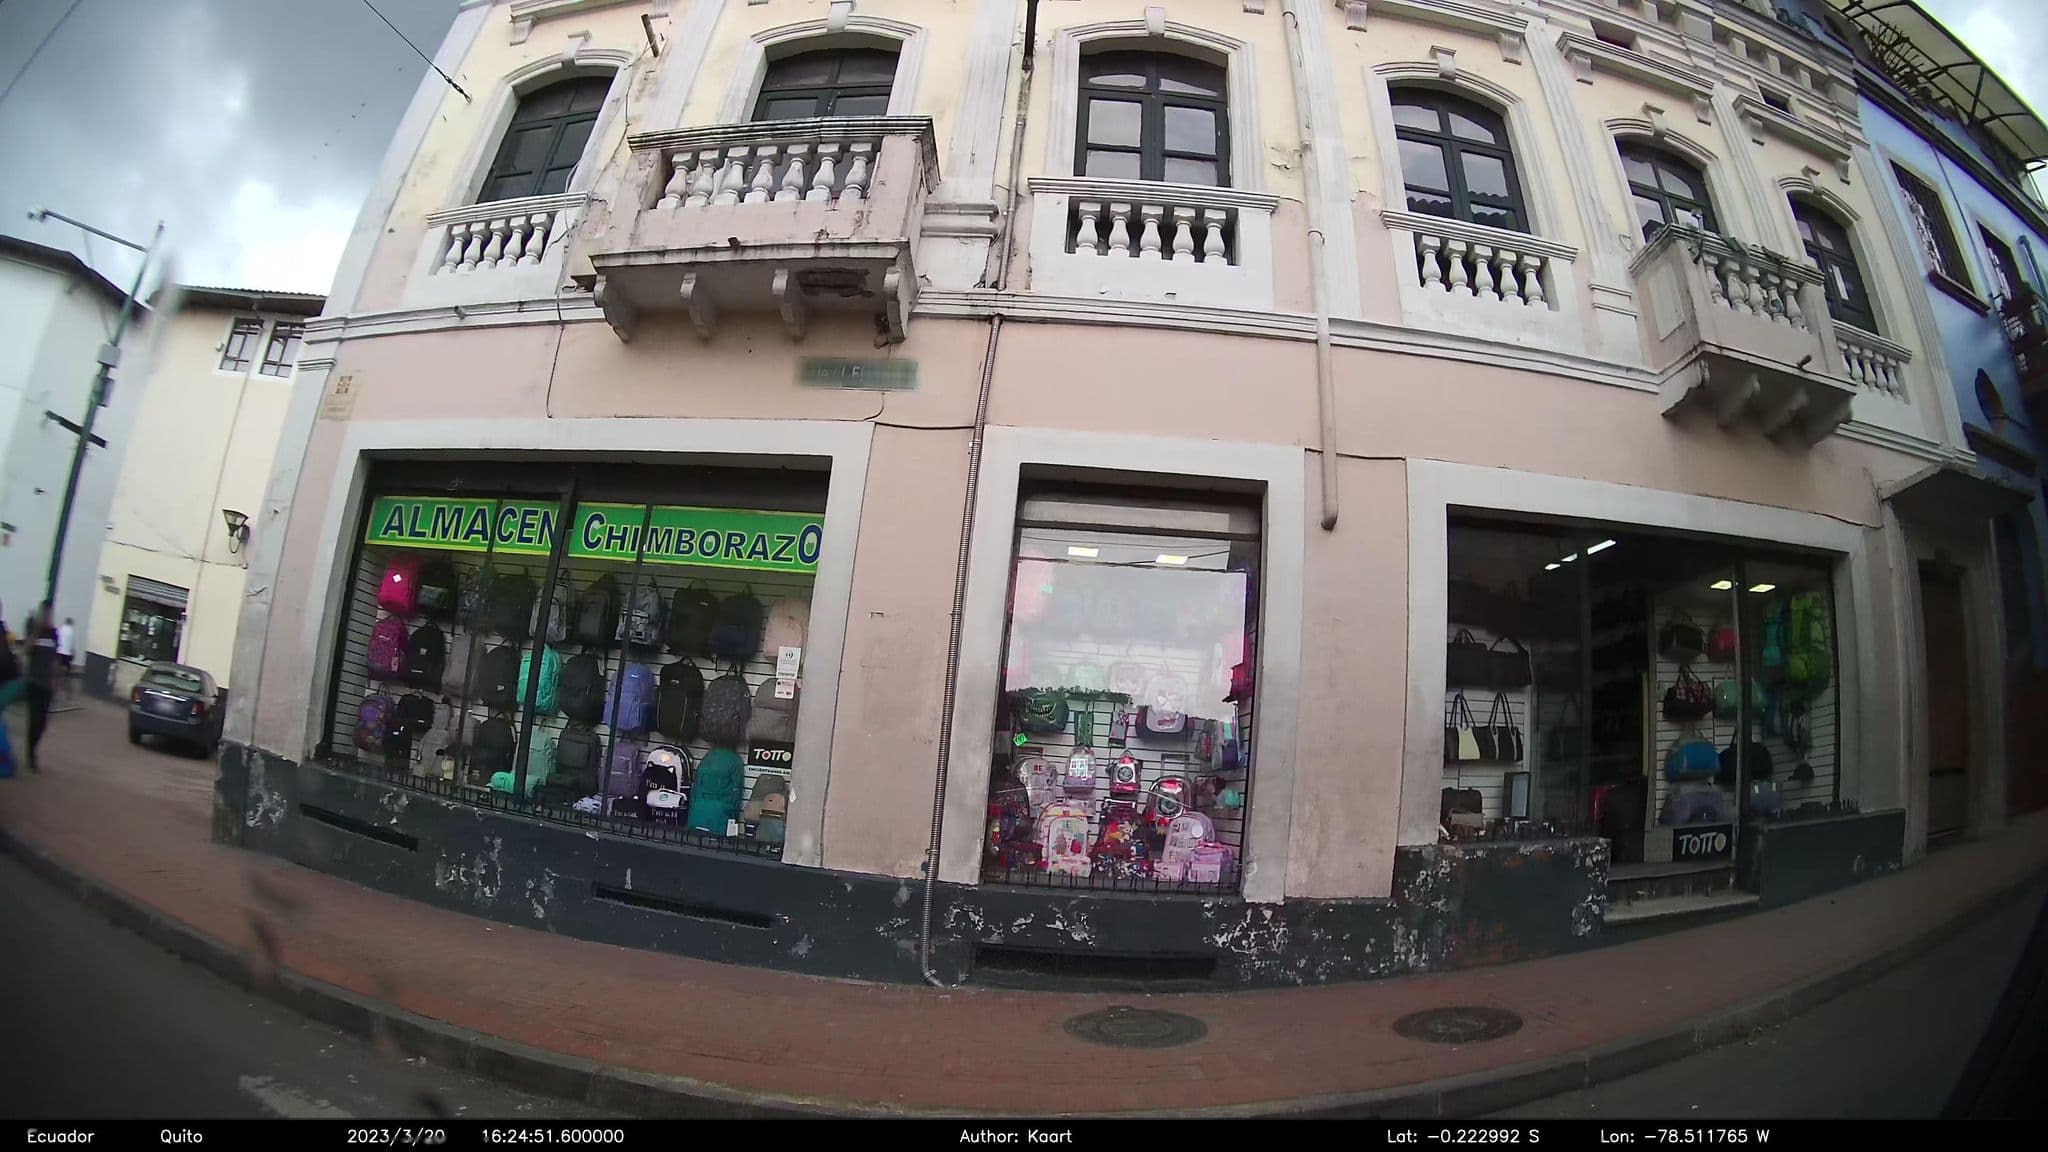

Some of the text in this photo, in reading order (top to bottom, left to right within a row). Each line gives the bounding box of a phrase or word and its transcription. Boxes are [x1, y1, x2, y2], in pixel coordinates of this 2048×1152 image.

[379, 504, 824, 565] ALMACEN CHIMBORAZO
[753, 748, 792, 762] TOTTO
[1679, 831, 1727, 856] TOTTO
